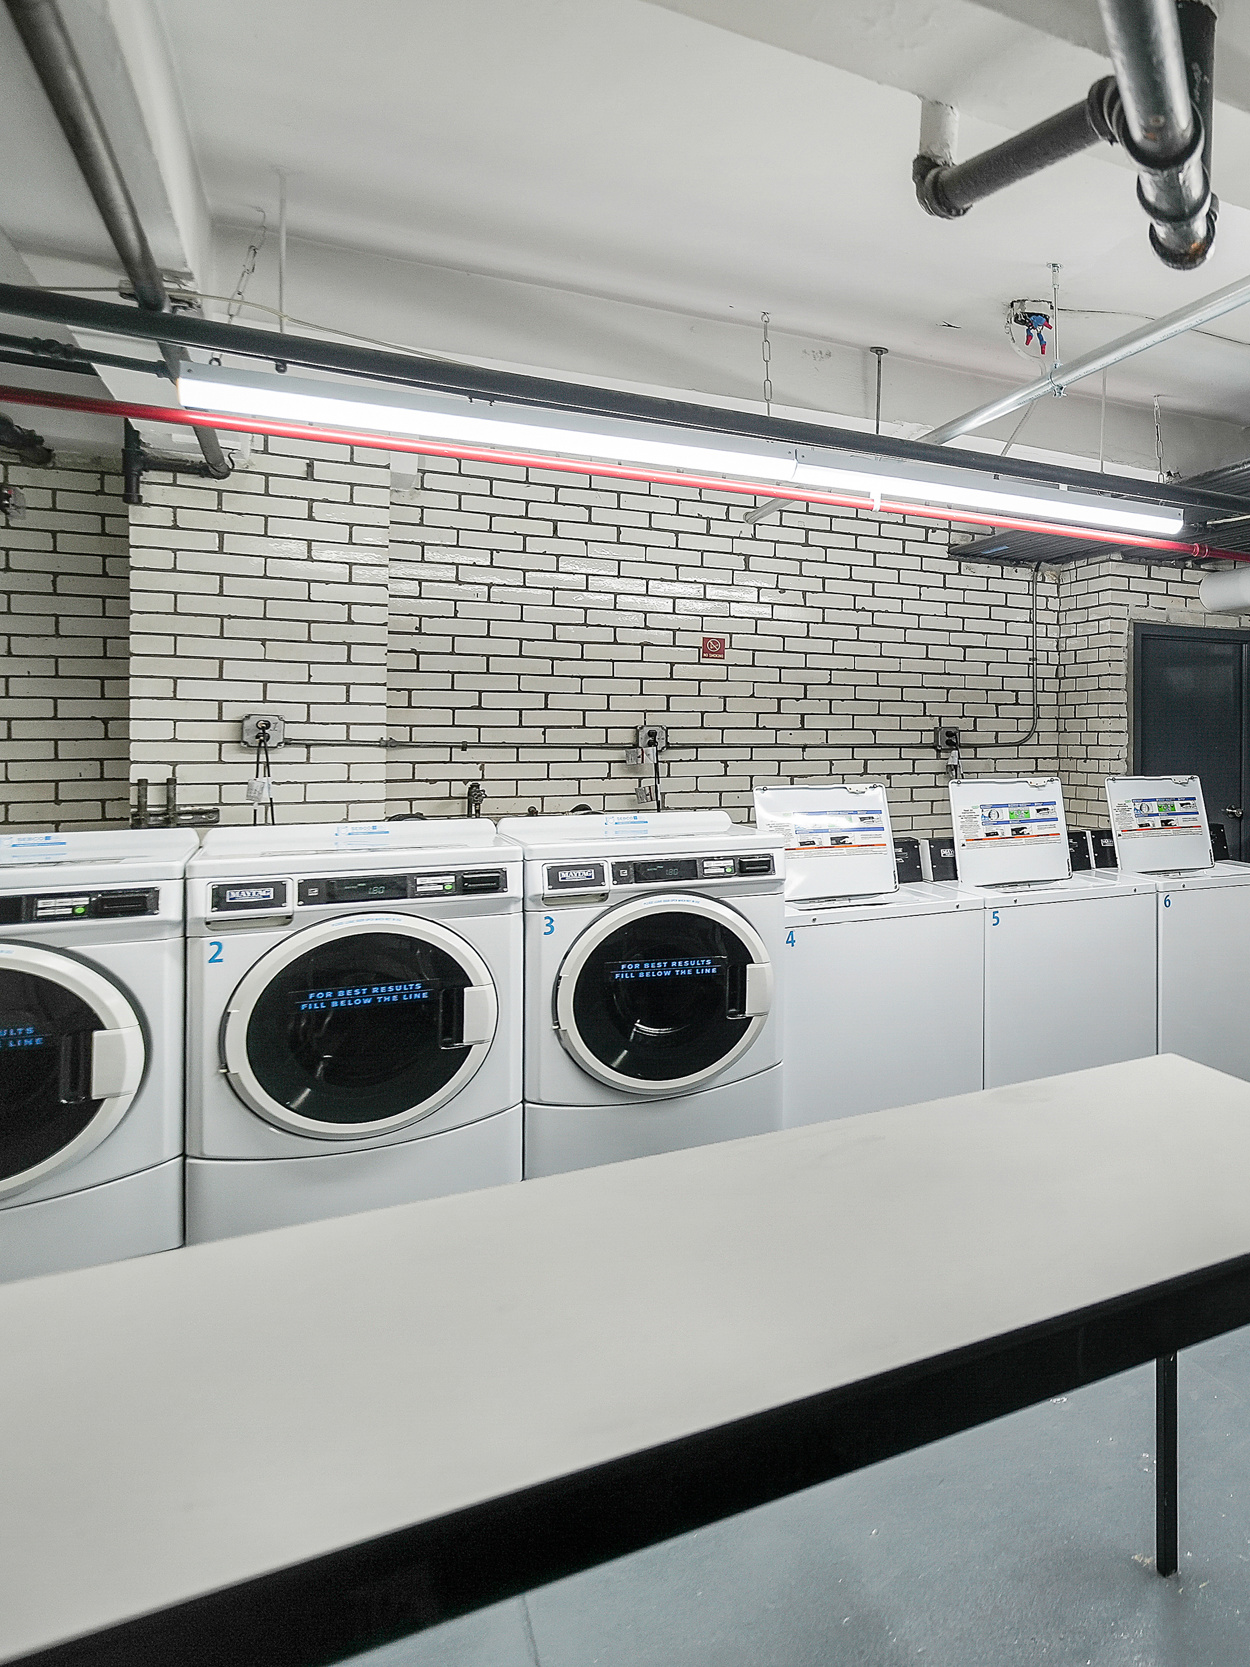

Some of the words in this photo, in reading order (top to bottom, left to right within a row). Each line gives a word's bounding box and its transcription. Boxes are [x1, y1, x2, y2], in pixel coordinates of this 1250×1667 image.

[560, 870, 593, 878] MAYTAG
[1163, 894, 1171, 908] 6
[543, 915, 555, 936] 3
[992, 910, 1000, 926] 5
[785, 930, 796, 948] 4
[208, 941, 224, 964] 2
[644, 961, 668, 969] BEST
[671, 959, 712, 967] RESULTS
[614, 972, 635, 980] FILL
[638, 970, 671, 978] BELOW
[675, 968, 693, 976] THE
[696, 967, 717, 975] LINE
[308, 991, 333, 1000] FOR
[337, 988, 368, 997] BEST
[371, 982, 423, 994] RESULTS
[300, 1002, 327, 1011] FILL
[331, 997, 373, 1008] BELOW
[377, 994, 399, 1003] THE
[402, 991, 429, 1001] LINE
